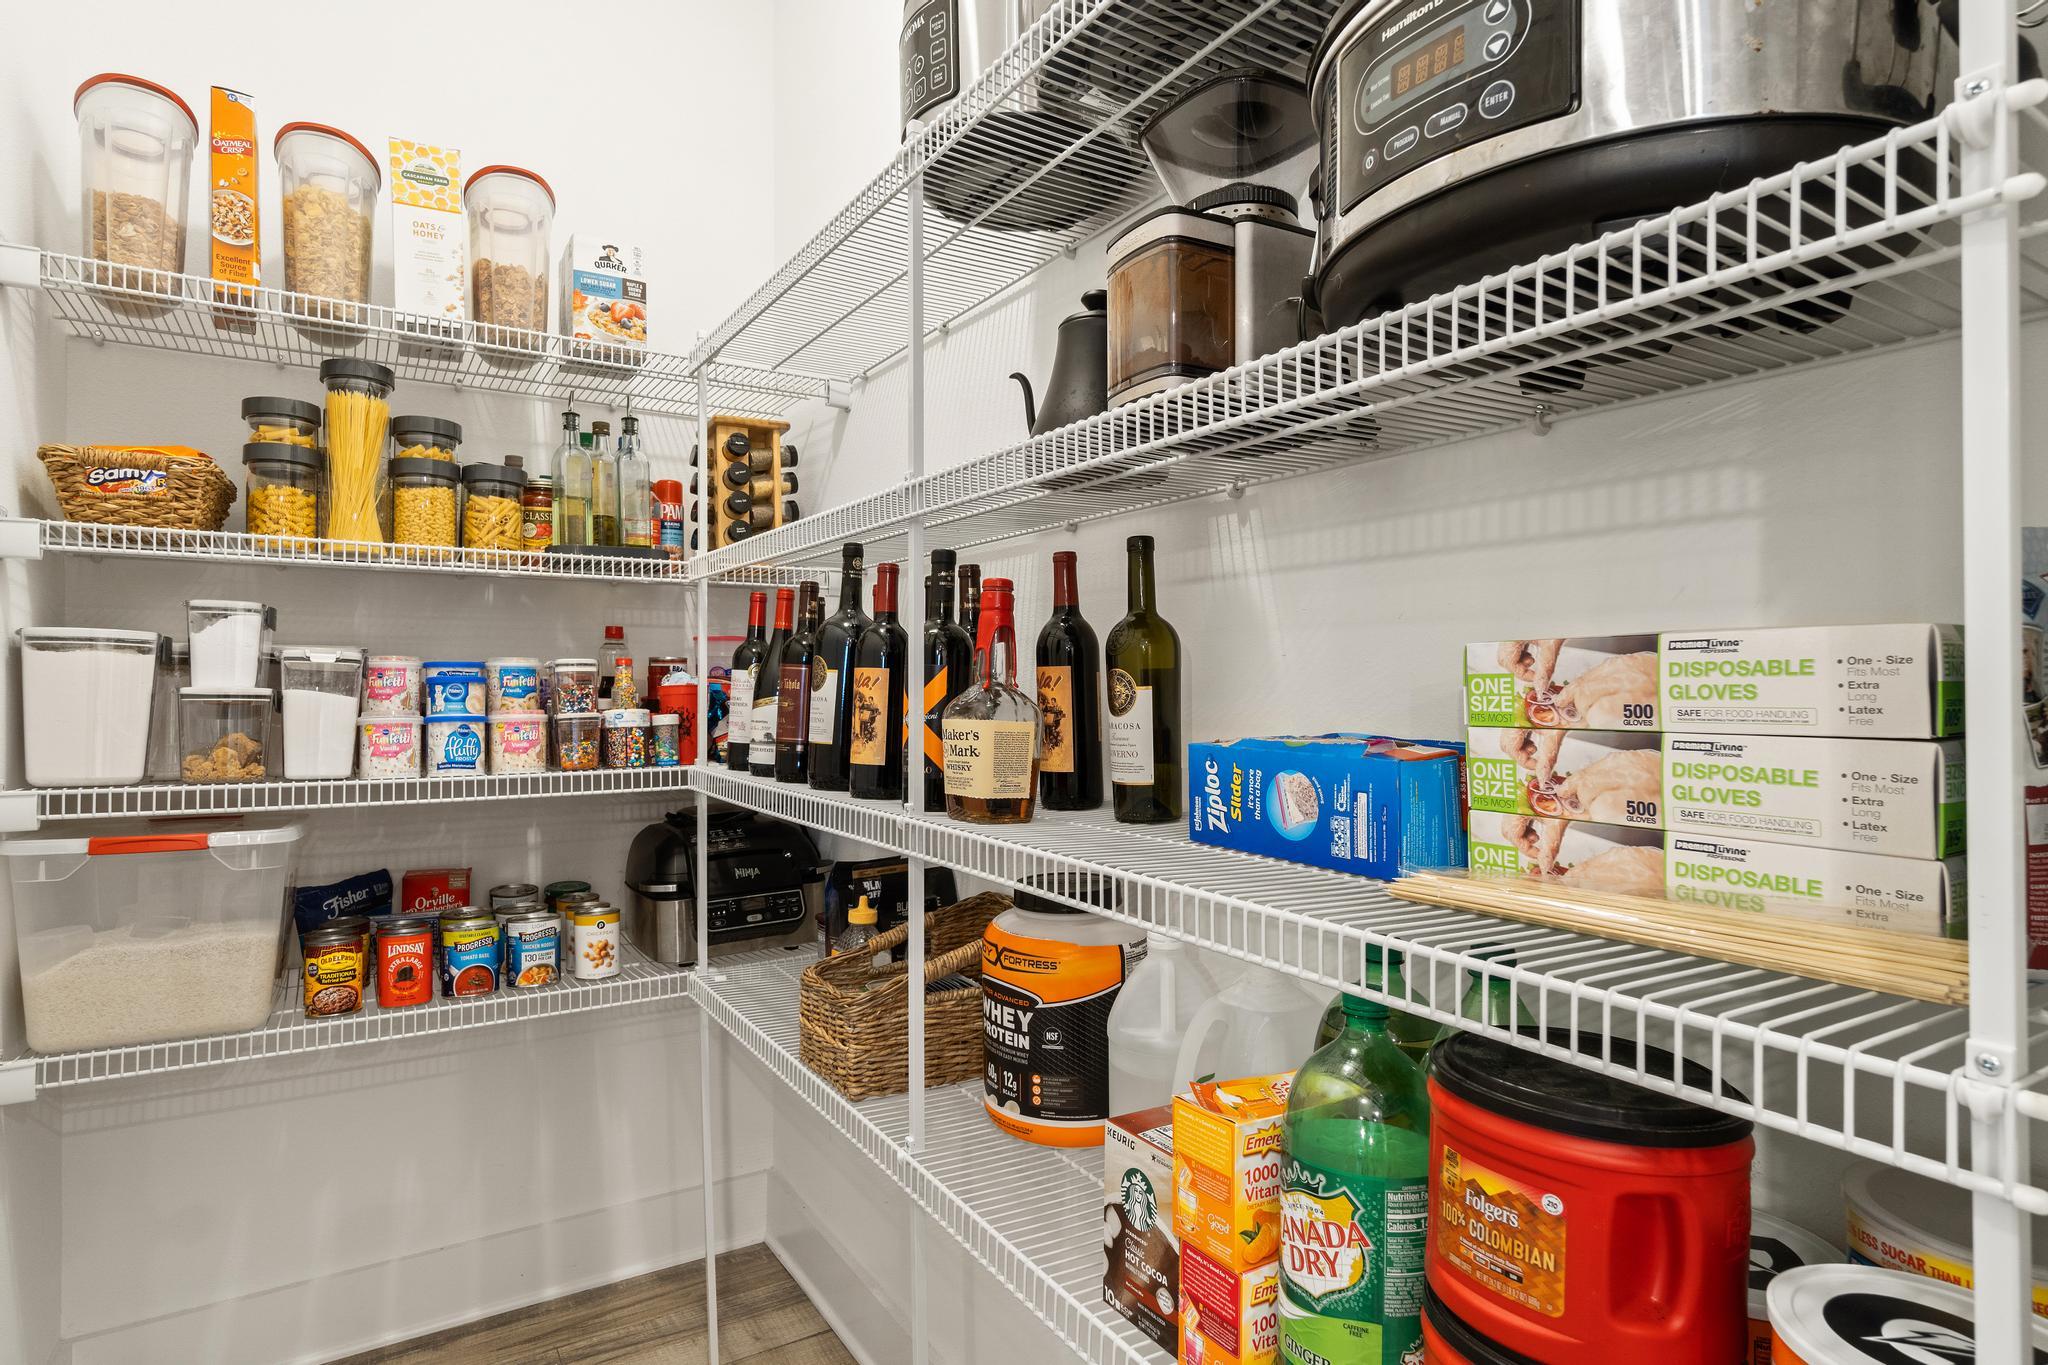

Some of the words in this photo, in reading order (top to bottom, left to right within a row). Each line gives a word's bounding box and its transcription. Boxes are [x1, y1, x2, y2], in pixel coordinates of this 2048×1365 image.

[1381, 0, 1433, 42] Hamilton
[1484, 90, 1509, 108] ENTER
[212, 139, 252, 149] OATMEAL
[412, 221, 436, 230] OATS
[412, 230, 445, 240] HONEY
[215, 253, 251, 265] Excellent
[220, 261, 247, 272] Source
[228, 269, 248, 278] Fiber
[594, 260, 628, 274] QUAKER
[580, 277, 599, 286] LOWER
[660, 503, 683, 521] PAM
[1668, 657, 1816, 678] DISPOSABLE
[1846, 656, 1872, 666] One
[1885, 655, 1913, 665] Size
[1847, 667, 1869, 677] Fits
[1870, 667, 1901, 677] Most
[368, 676, 404, 688] Funfetti
[503, 675, 536, 687] Funfetti
[1470, 678, 1513, 695] ONE
[1847, 681, 1880, 690] Extra
[1668, 683, 1758, 701] GLOVES
[1847, 691, 1877, 703] Long
[1470, 695, 1513, 712] SIZE
[1848, 705, 1884, 715] Latex
[1470, 713, 1486, 723] FITS
[1487, 713, 1512, 722] MOST
[1623, 704, 1654, 719] 500
[1677, 709, 1701, 718] SAFE
[1703, 709, 1722, 718] FOR
[1726, 710, 1753, 719] FOOD
[1756, 710, 1809, 719] HANDLING
[1622, 719, 1654, 727] GLOVES
[1848, 716, 1874, 726] Free
[372, 733, 411, 744] Funfetti
[504, 730, 538, 741] Funfetti
[942, 728, 980, 741] Maker's
[445, 736, 479, 760] fluffy
[949, 744, 979, 758] Mark
[946, 763, 972, 772] WHISKY
[1472, 761, 1514, 780] ONE
[1672, 761, 1819, 788] DISPOSABLE
[1254, 769, 1263, 788] bag
[1851, 771, 1877, 782] One
[1890, 774, 1919, 786] Size
[1230, 762, 1242, 822] Slider
[1472, 780, 1515, 798] SIZE
[1672, 784, 1762, 808] GLOVES
[1851, 782, 1873, 793] Fits
[1874, 784, 1905, 796] Most
[1204, 760, 1229, 834] Ziploc
[1473, 797, 1488, 807] FITS
[1490, 799, 1516, 809] MOST
[1852, 796, 1884, 808] Extra
[1626, 800, 1657, 817] 500
[1851, 807, 1881, 820] Long
[1626, 815, 1657, 825] GLOVES
[1680, 809, 1705, 820] SAFE
[1706, 812, 1727, 822] FOR
[1729, 814, 1757, 825] FOOD
[1759, 816, 1813, 831] HANDLING
[1852, 821, 1888, 833] Latex
[1852, 831, 1879, 843] Free
[1474, 846, 1516, 866] ONE
[734, 867, 761, 880] NINJA
[1674, 861, 1823, 898] DISPOSABLE
[1674, 884, 1765, 913] GLOVES
[1855, 884, 1882, 897] One
[1895, 889, 1924, 902] Size
[322, 888, 369, 920] Fisher
[415, 893, 456, 910] Orville
[1855, 896, 1877, 907] Fits
[1879, 899, 1910, 912] Most
[1856, 909, 1888, 922] Extra
[521, 927, 556, 942] PROGRESSO
[387, 942, 425, 958] LINDSAY
[457, 936, 493, 952] PROGRESSO
[388, 957, 406, 973] EXTRA
[406, 956, 423, 970] LARGE
[460, 953, 479, 961] TOMATO
[524, 953, 537, 963] 130
[1003, 954, 1058, 971] FORTRESS
[320, 970, 355, 980] TRADITIONAL
[993, 992, 1030, 1007] ADVANCED
[983, 994, 1034, 1033] WHEY
[983, 1016, 1030, 1050] PROTEIN
[1045, 1031, 1059, 1041] NSF
[1003, 1070, 1017, 1092] 12g
[1106, 1126, 1136, 1151] KEURIG
[1244, 1162, 1279, 1187] 1,000
[1387, 1192, 1420, 1202] Nutrition
[1464, 1187, 1520, 1228] Folgers
[1281, 1214, 1372, 1249] ANADA
[1387, 1222, 1417, 1231] Calories
[1442, 1200, 1466, 1226] 100%
[1469, 1218, 1555, 1273] COLOMBIAN
[1290, 1246, 1340, 1278] DRY
[1857, 1227, 1879, 1251] LESS
[1880, 1241, 1927, 1274] SUGAR
[1929, 1265, 1962, 1287] THAN
[1124, 1249, 1140, 1267] HOT
[1141, 1261, 1168, 1287] COCOA
[1104, 1285, 1115, 1306] 10
[1342, 1322, 1369, 1334] CAFFEINE
